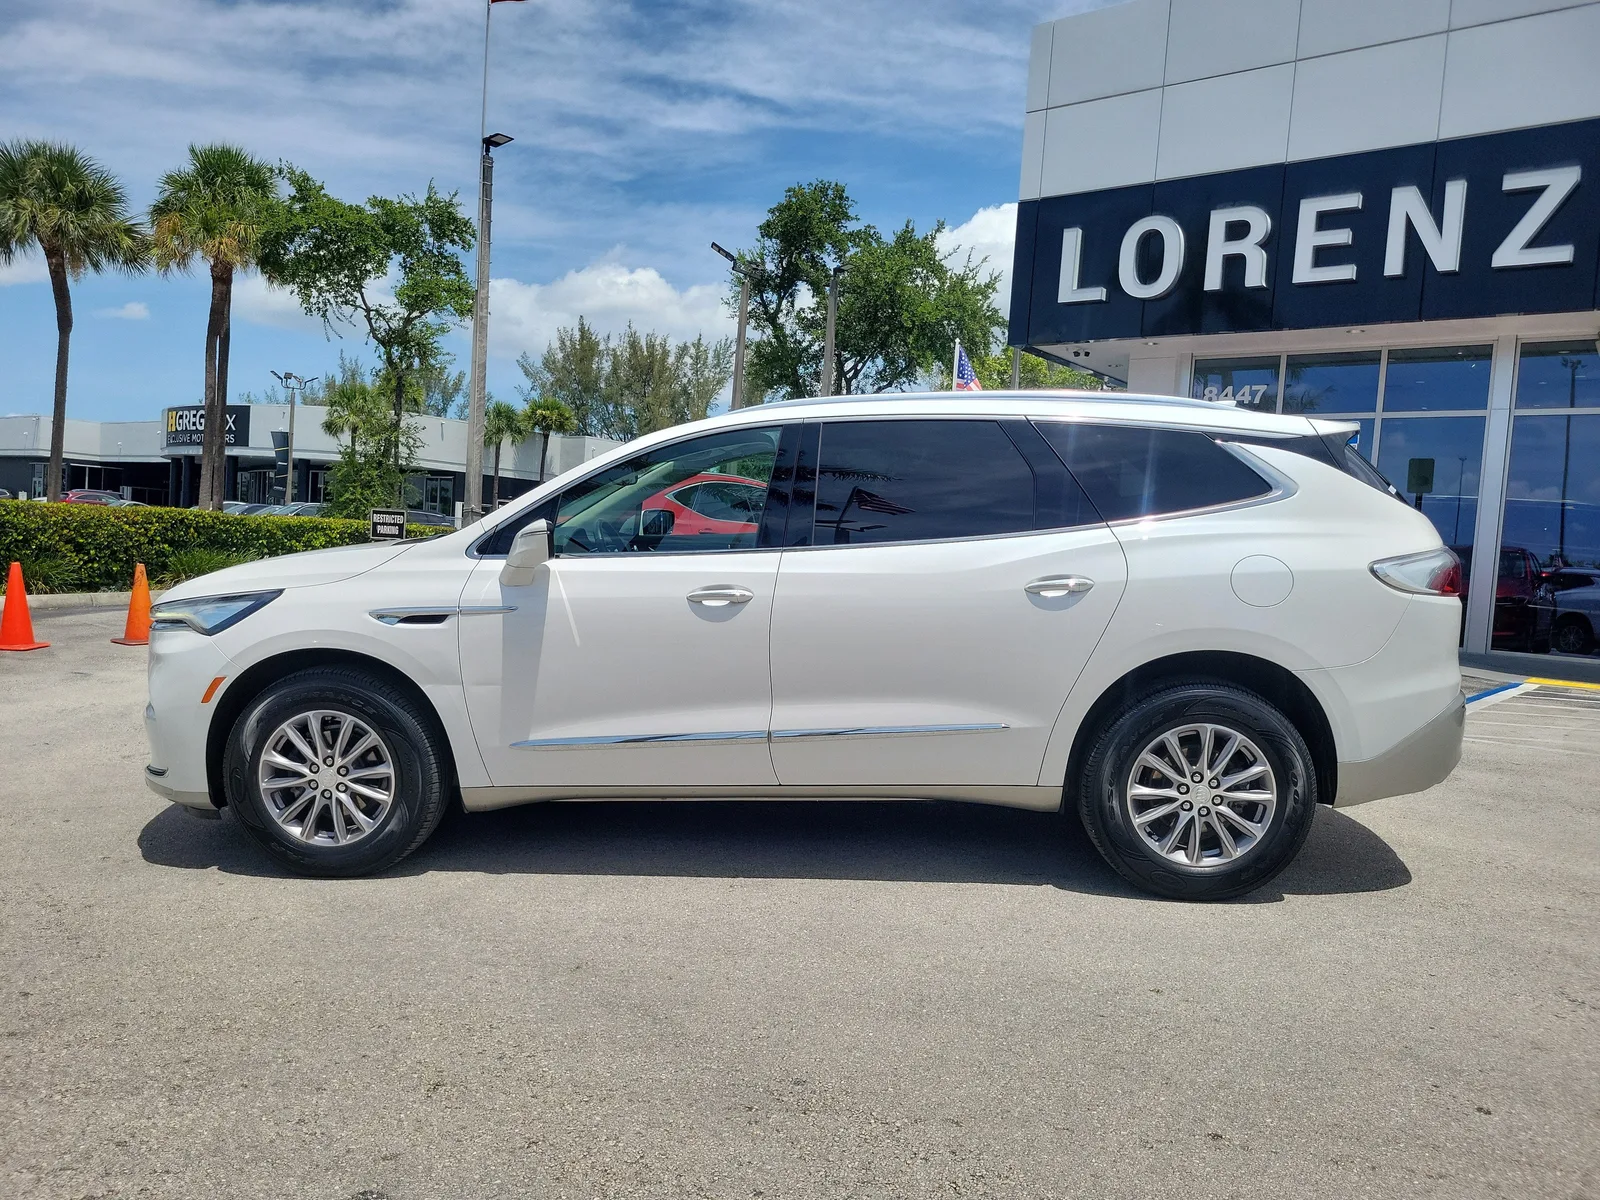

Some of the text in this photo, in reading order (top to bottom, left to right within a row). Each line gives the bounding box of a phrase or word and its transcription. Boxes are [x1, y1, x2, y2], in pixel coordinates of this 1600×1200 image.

[1057, 165, 1582, 304] LORENZ
[1203, 384, 1268, 404] 8447
[191, 434, 235, 443] MOTRS
[373, 514, 404, 524] RESTRICTED
[377, 525, 399, 535] PARKING
